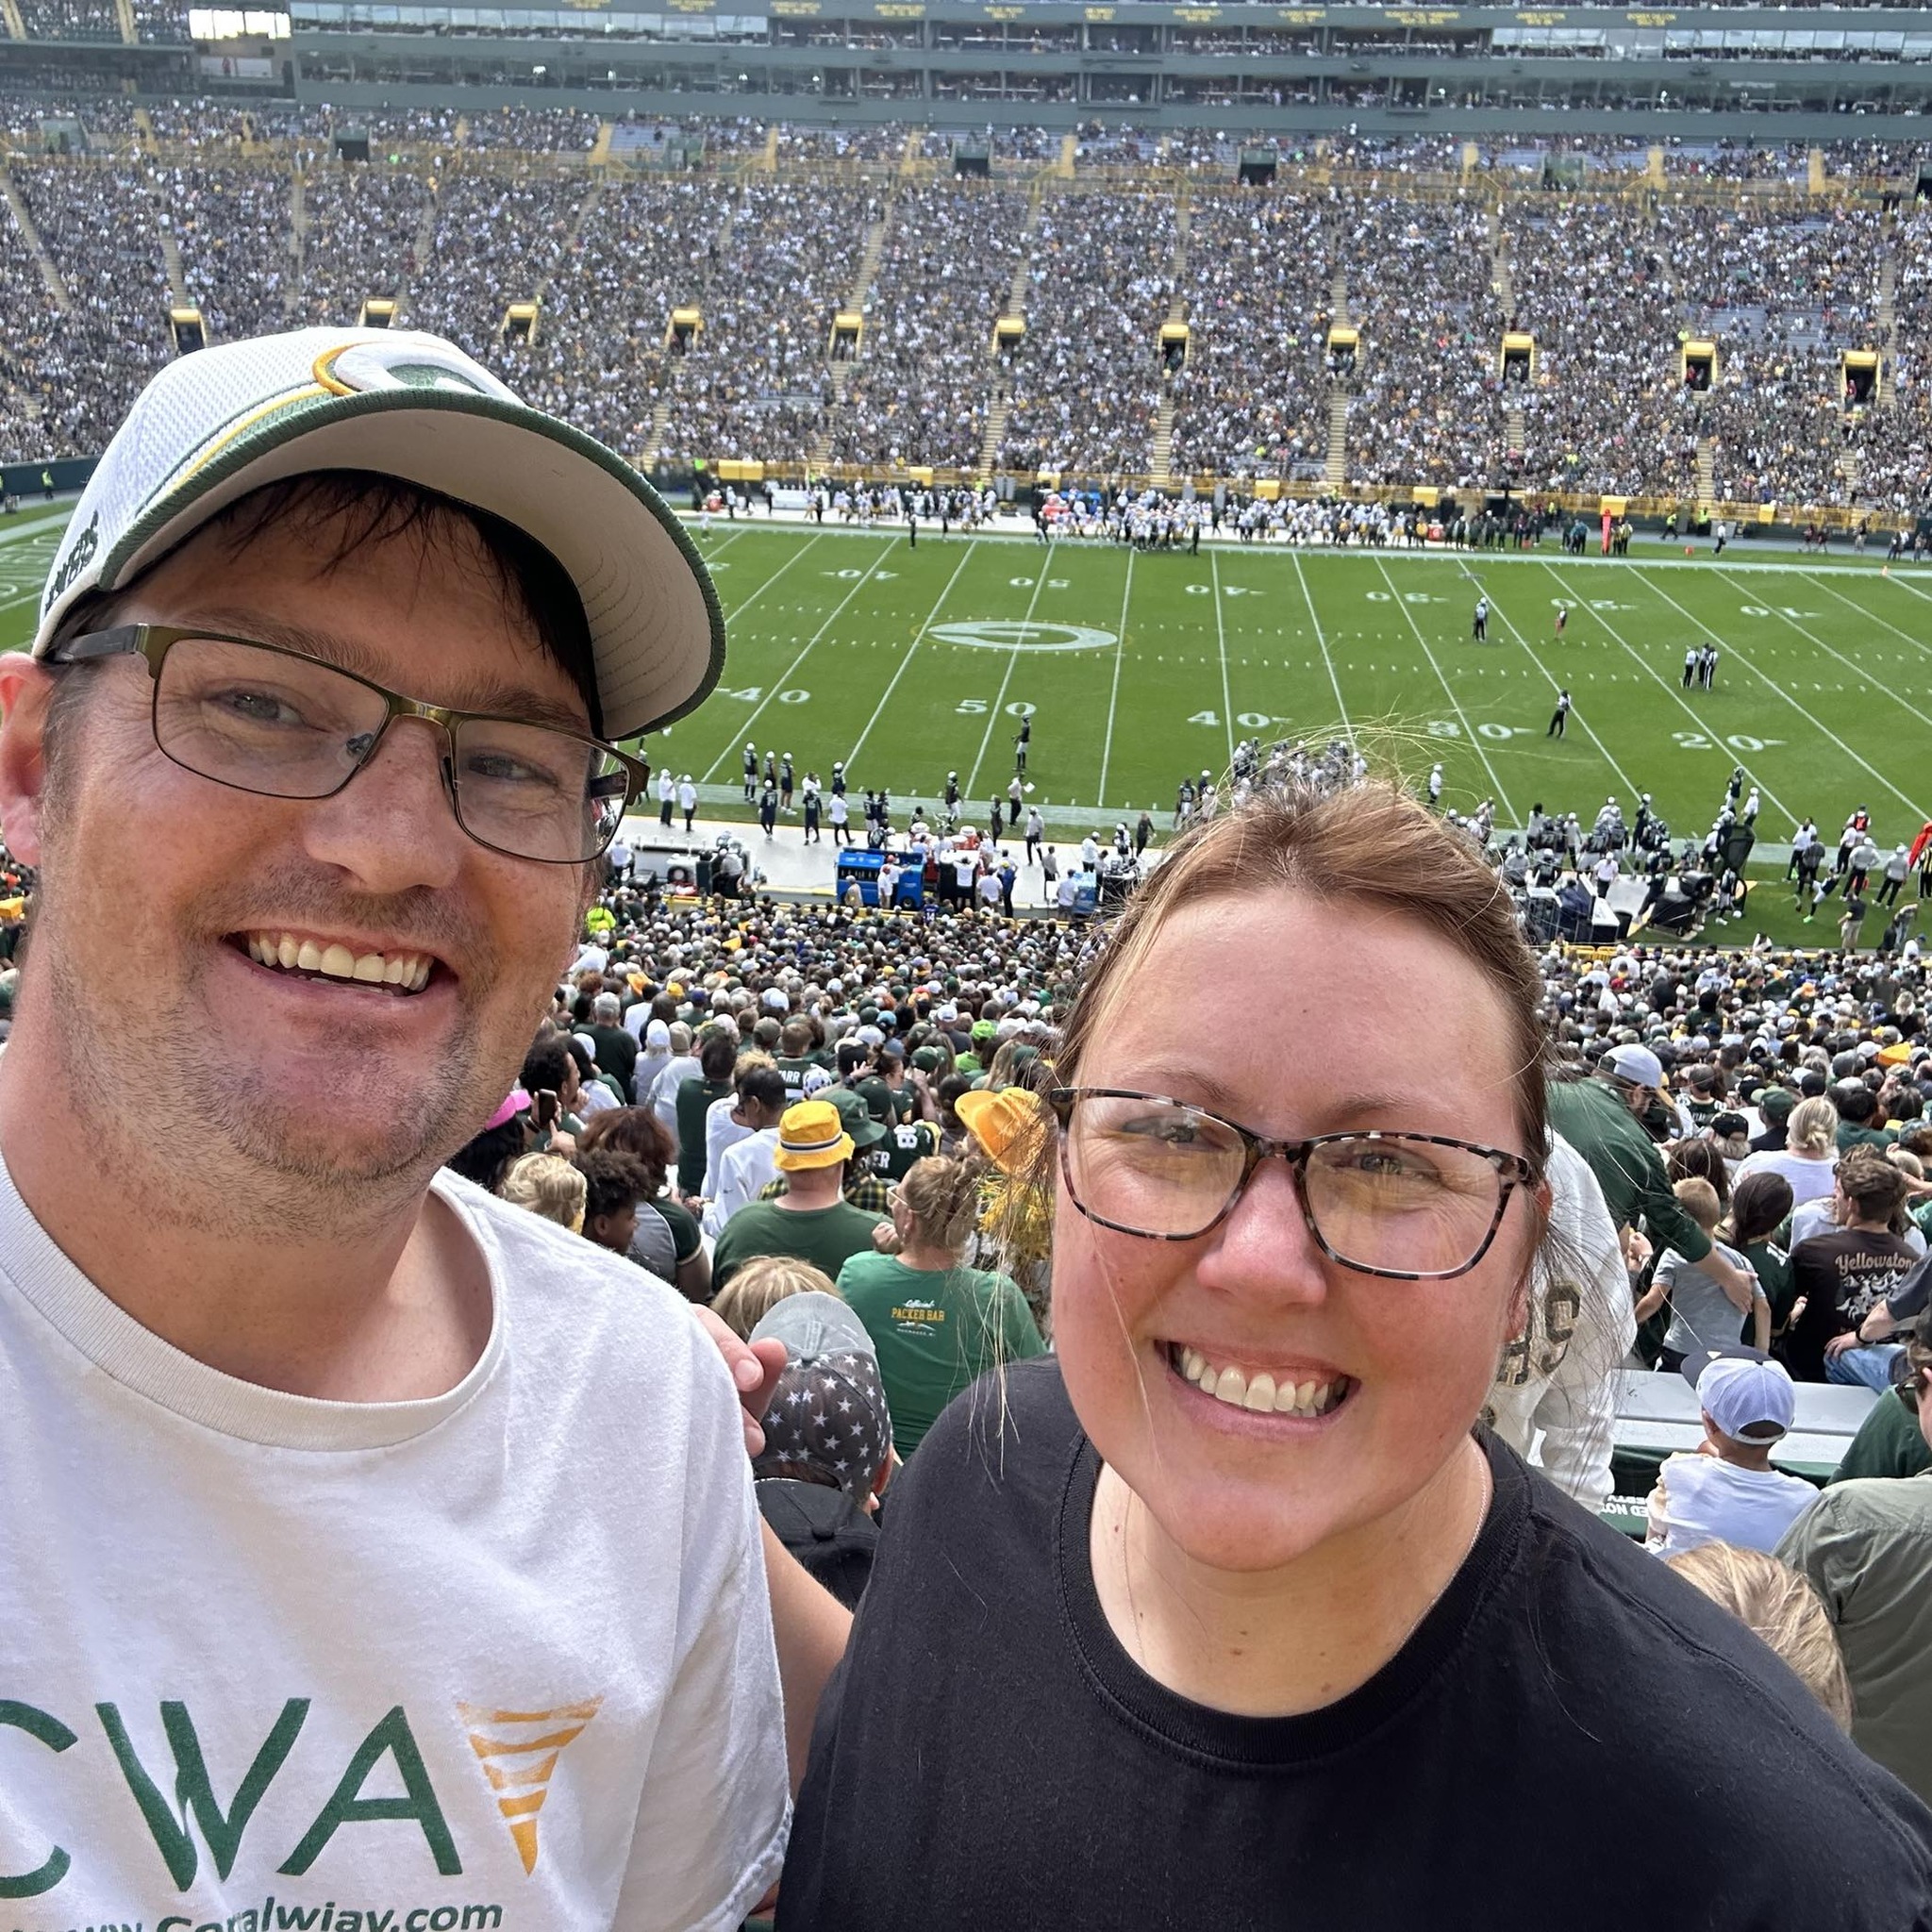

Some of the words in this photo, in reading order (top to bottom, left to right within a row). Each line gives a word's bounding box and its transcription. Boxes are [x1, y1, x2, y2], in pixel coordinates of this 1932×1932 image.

[730, 688, 810, 703] 40
[955, 699, 1037, 716] 50
[1187, 710, 1270, 728] 40
[1672, 732, 1764, 752] 20
[778, 1070, 801, 1083] ARR
[891, 1307, 925, 1321] PACKER
[926, 1309, 945, 1322] BAR
